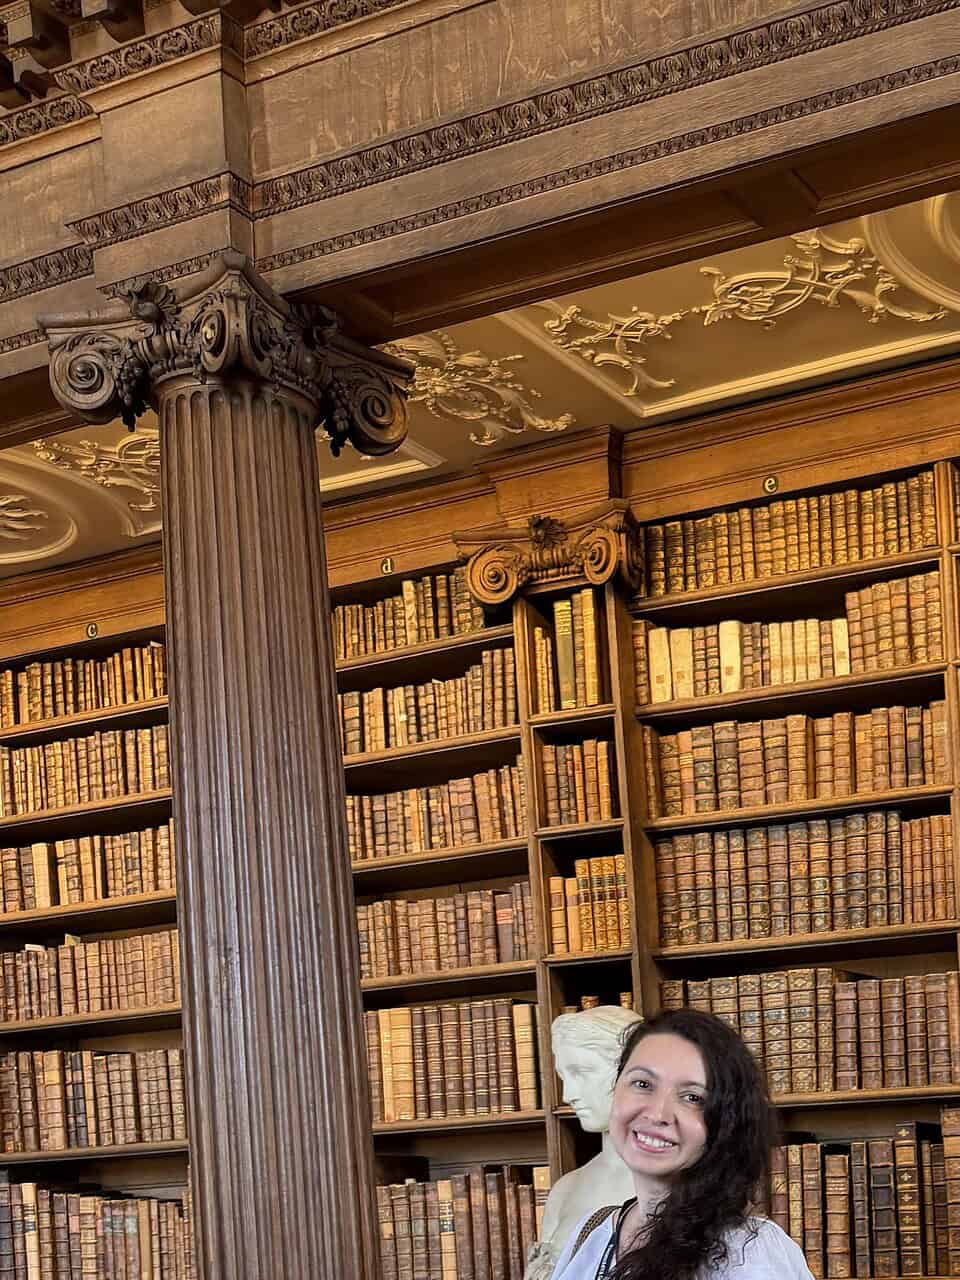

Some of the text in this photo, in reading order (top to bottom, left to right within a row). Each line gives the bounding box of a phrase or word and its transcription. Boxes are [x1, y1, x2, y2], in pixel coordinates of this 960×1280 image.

[765, 477, 776, 491] e
[382, 558, 392, 573] d
[87, 623, 97, 636] c
